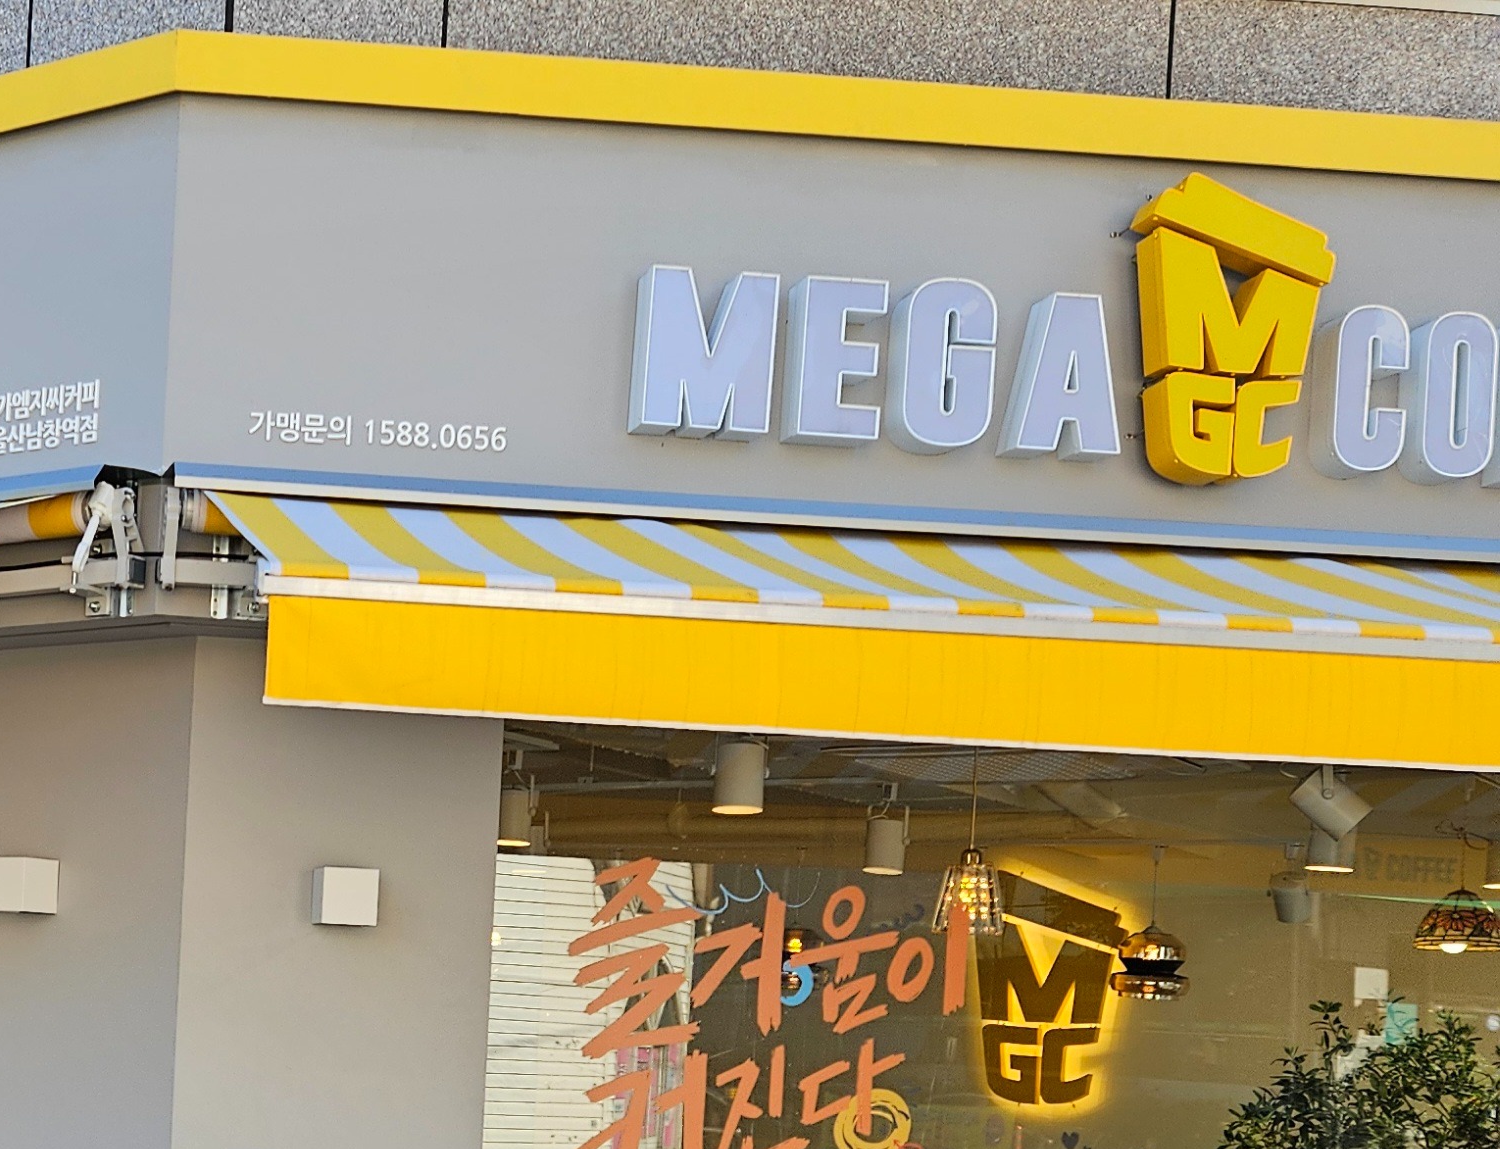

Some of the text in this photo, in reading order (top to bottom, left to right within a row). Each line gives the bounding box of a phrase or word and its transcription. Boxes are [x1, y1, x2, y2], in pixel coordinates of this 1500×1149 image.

[248, 410, 507, 452] 가맹문의 1588.0656
[627, 264, 1121, 462] MEGA
[1310, 304, 1500, 490] CO
[567, 857, 967, 1058] 즐거움이
